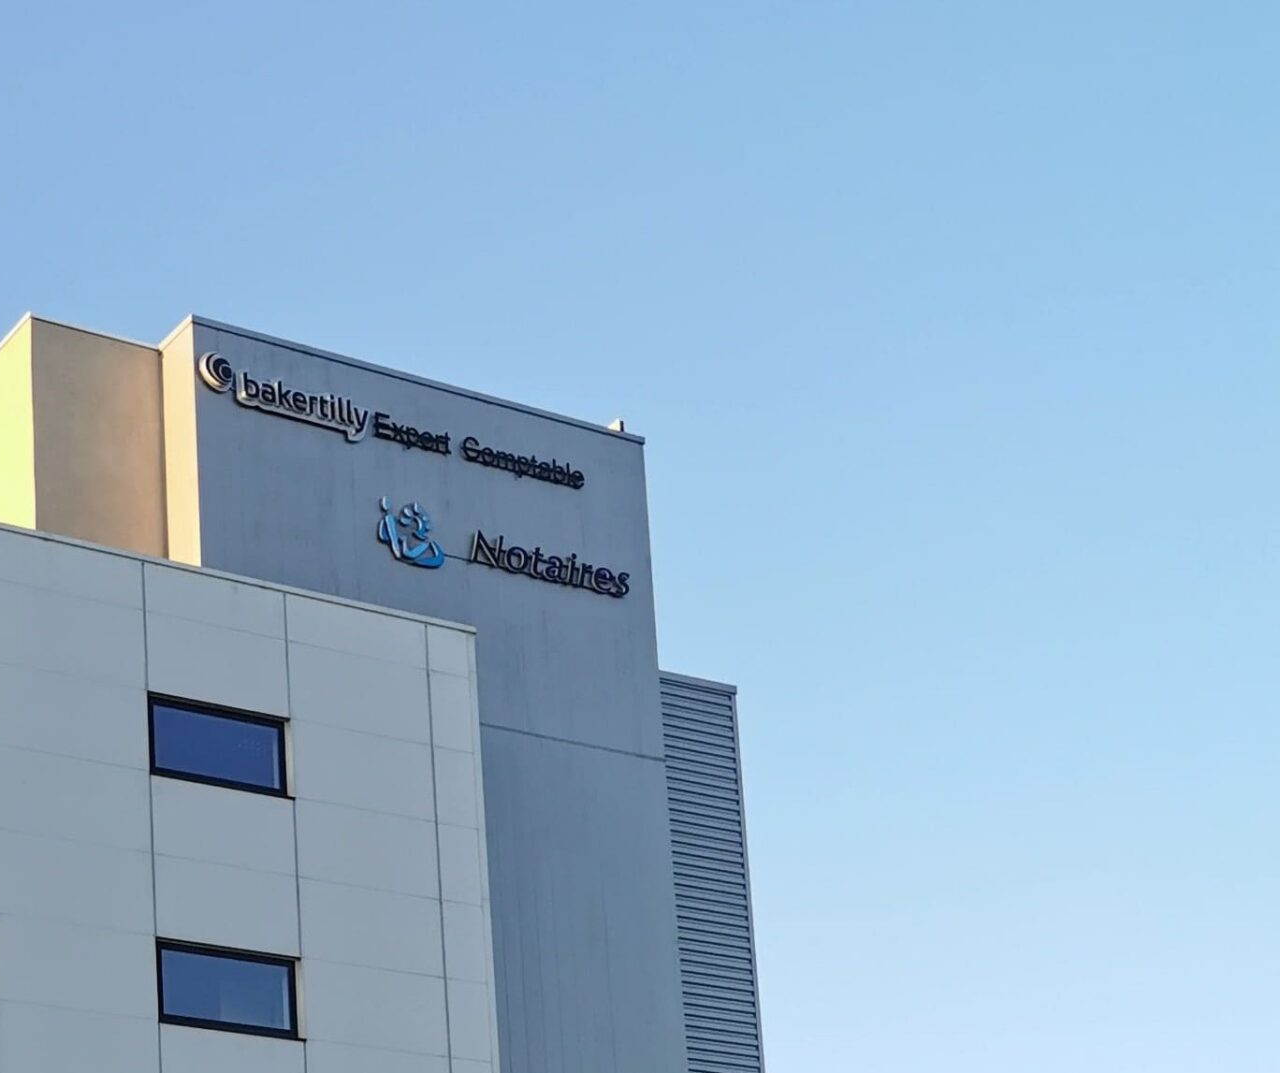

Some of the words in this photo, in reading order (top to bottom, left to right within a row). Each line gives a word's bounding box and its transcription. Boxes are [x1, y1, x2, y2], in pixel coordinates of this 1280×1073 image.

[241, 371, 369, 436] bakertilly
[373, 411, 451, 456] Expert
[461, 436, 585, 489] Comptable
[471, 530, 629, 598] Notaires
